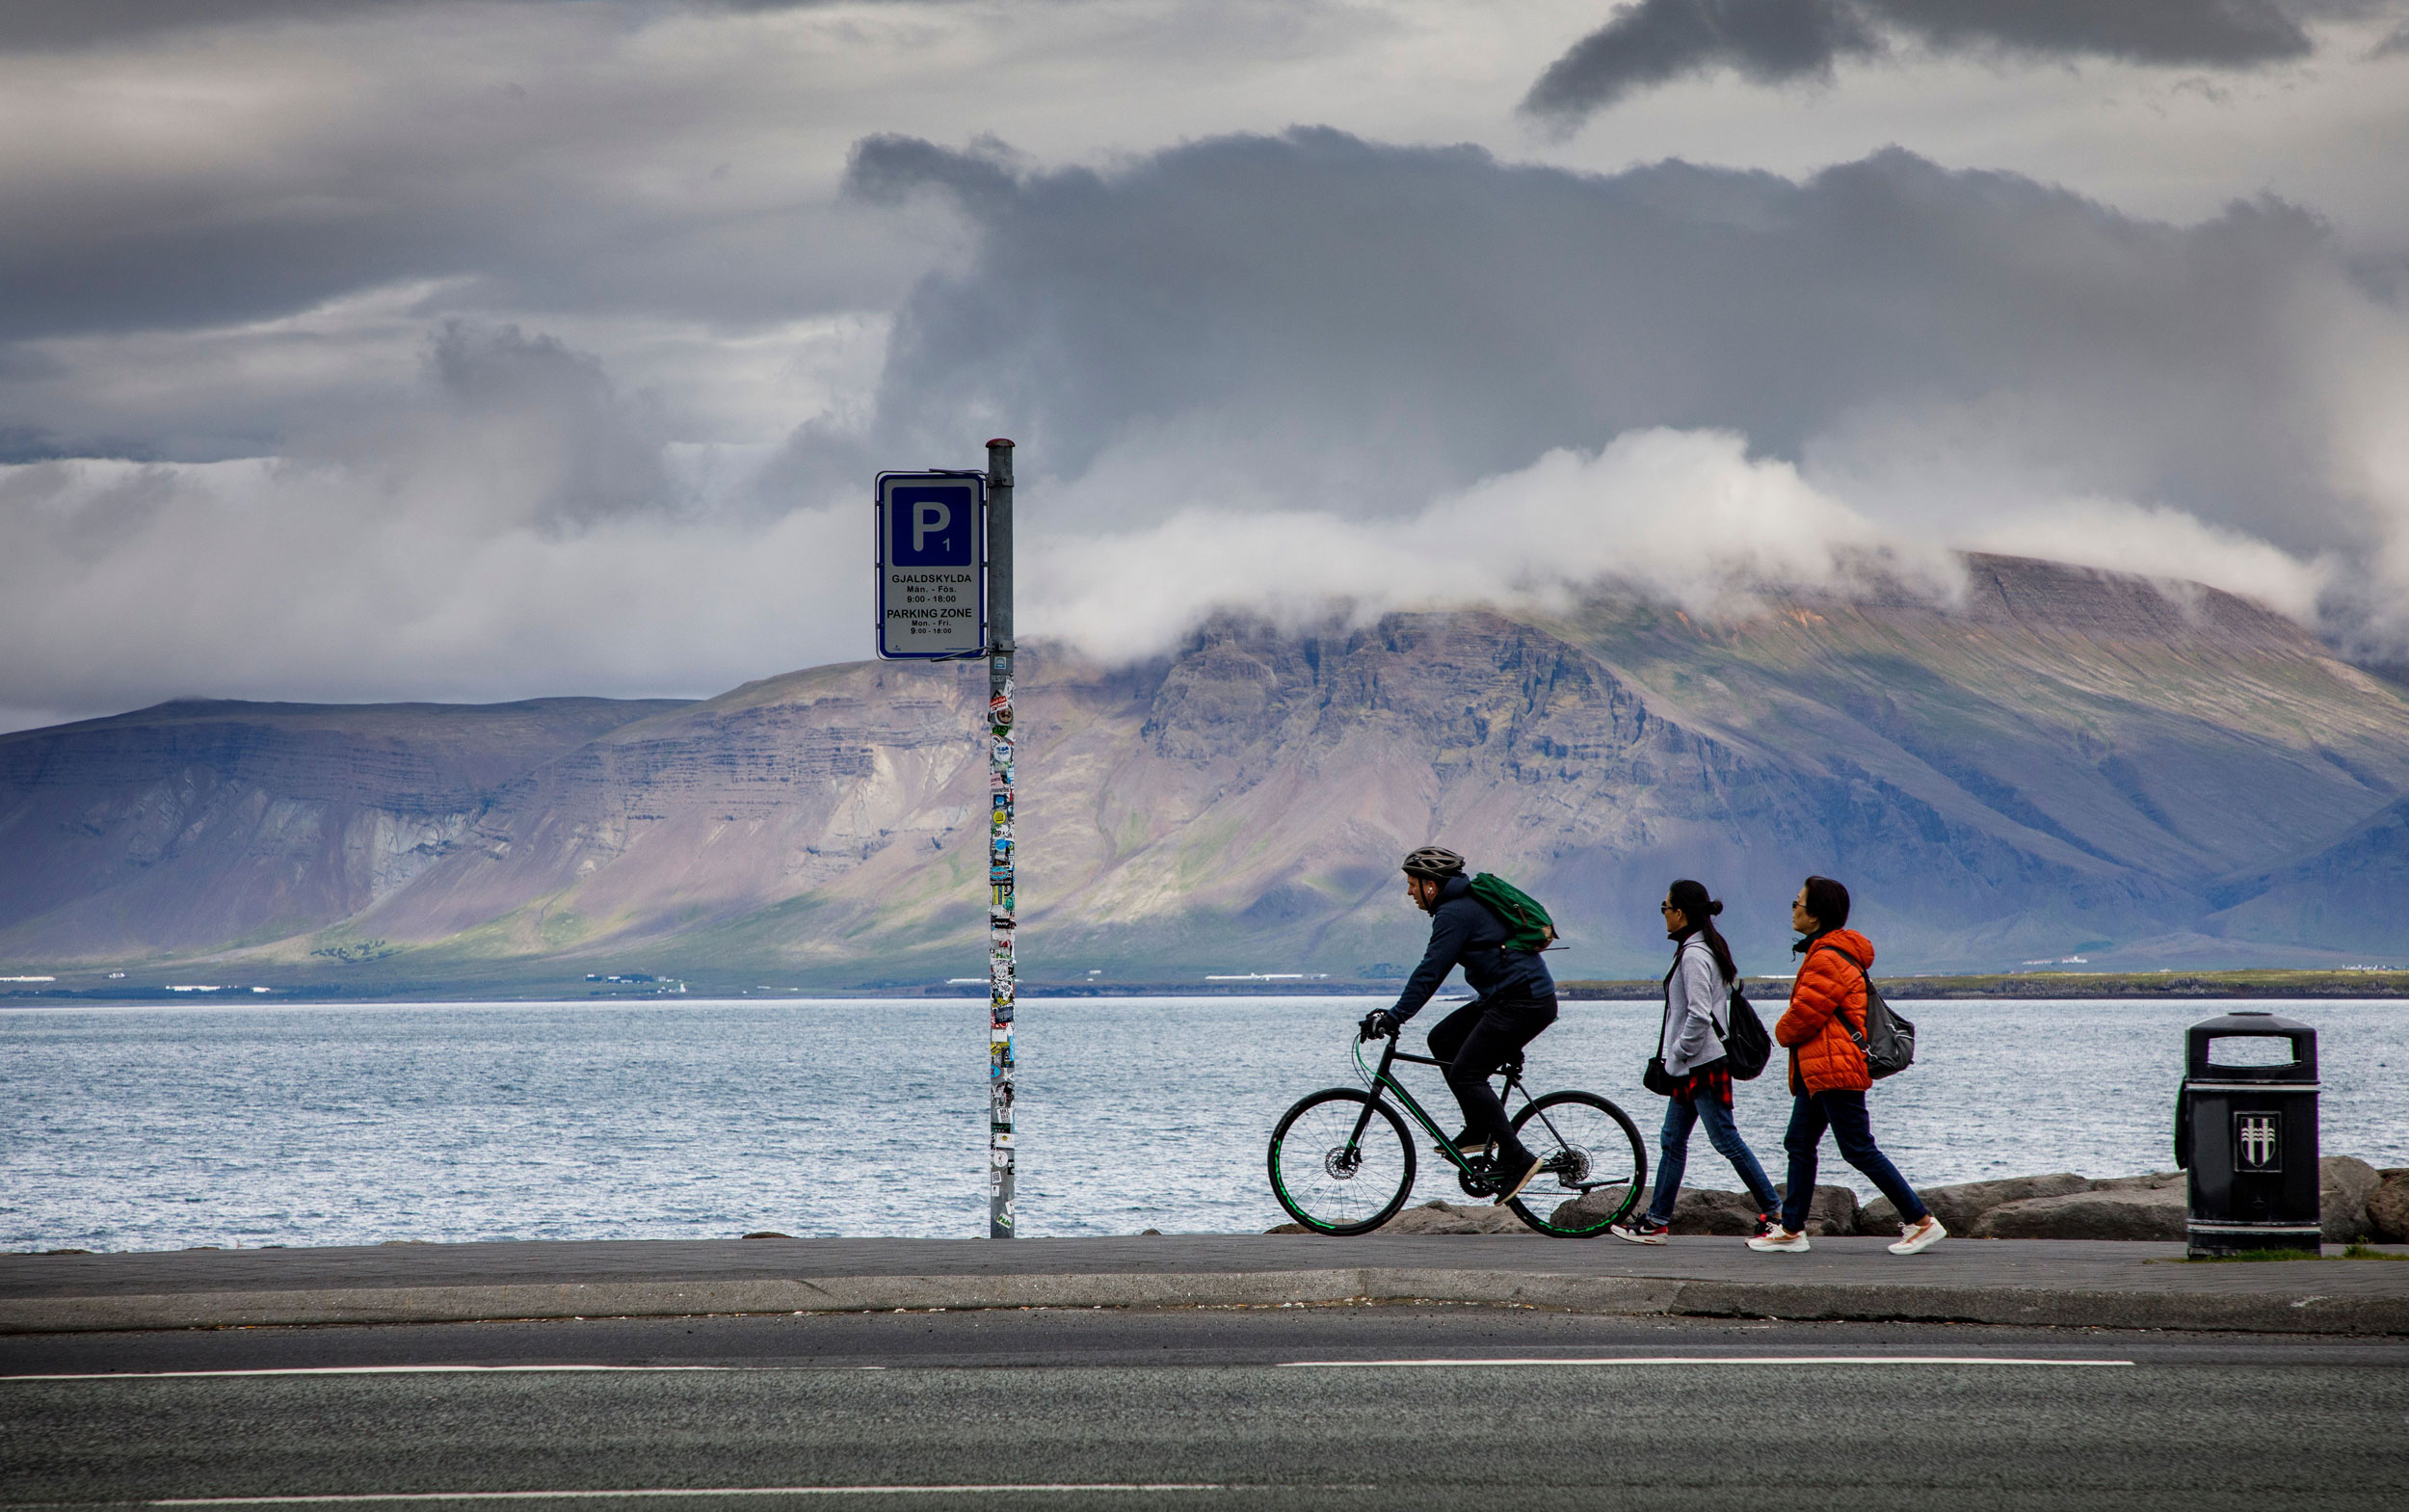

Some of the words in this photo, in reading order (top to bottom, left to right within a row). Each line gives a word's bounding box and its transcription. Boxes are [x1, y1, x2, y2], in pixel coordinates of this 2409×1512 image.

[913, 501, 951, 552] P
[942, 538, 950, 552] 1
[892, 574, 972, 583] GJALDSKYLDA
[887, 609, 938, 619] PARKING
[940, 608, 972, 618] ZONE
